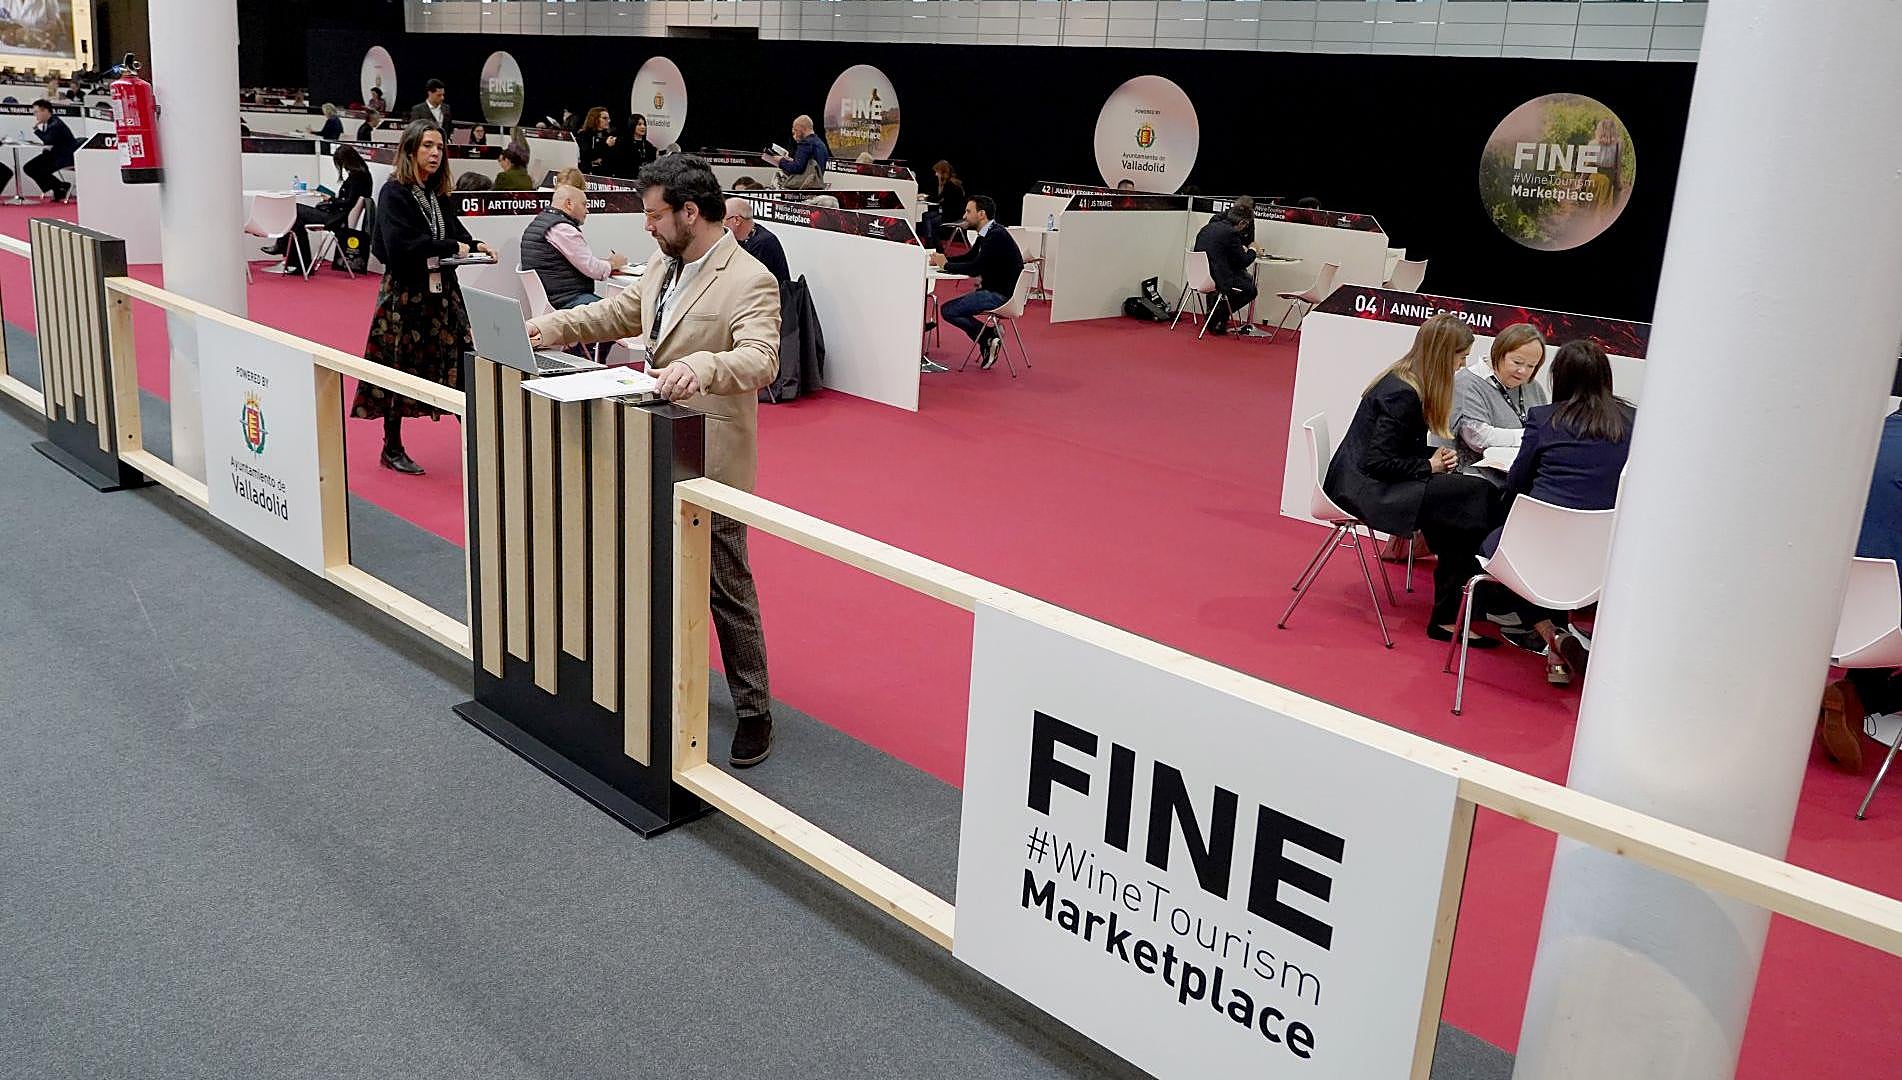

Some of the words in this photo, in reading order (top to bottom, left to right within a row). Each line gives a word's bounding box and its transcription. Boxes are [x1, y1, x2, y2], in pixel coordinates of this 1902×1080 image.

[841, 98, 883, 120] FINE
[825, 161, 837, 170] NE
[1121, 160, 1166, 172] Valladolid
[1513, 142, 1600, 173] FINE
[1041, 185, 1051, 194] 42
[1512, 171, 1595, 189] #WineTourism
[1511, 185, 1594, 202] Marketplace
[461, 198, 479, 212] 05
[488, 199, 537, 210] ARTTOURS
[774, 211, 811, 225] Marketplace
[1355, 295, 1377, 314] 04
[1390, 302, 1435, 319] ANNIE
[1450, 310, 1493, 328] SPAIN
[236, 366, 261, 385] POWERED
[262, 376, 270, 389] BY
[230, 456, 276, 489] Ayuntamiento
[278, 478, 286, 493] de
[231, 472, 289, 521] Valladolid
[1026, 709, 1346, 952] FINE
[1025, 826, 1322, 1006] #WineTourism
[1020, 868, 1316, 1060] Marketplace
